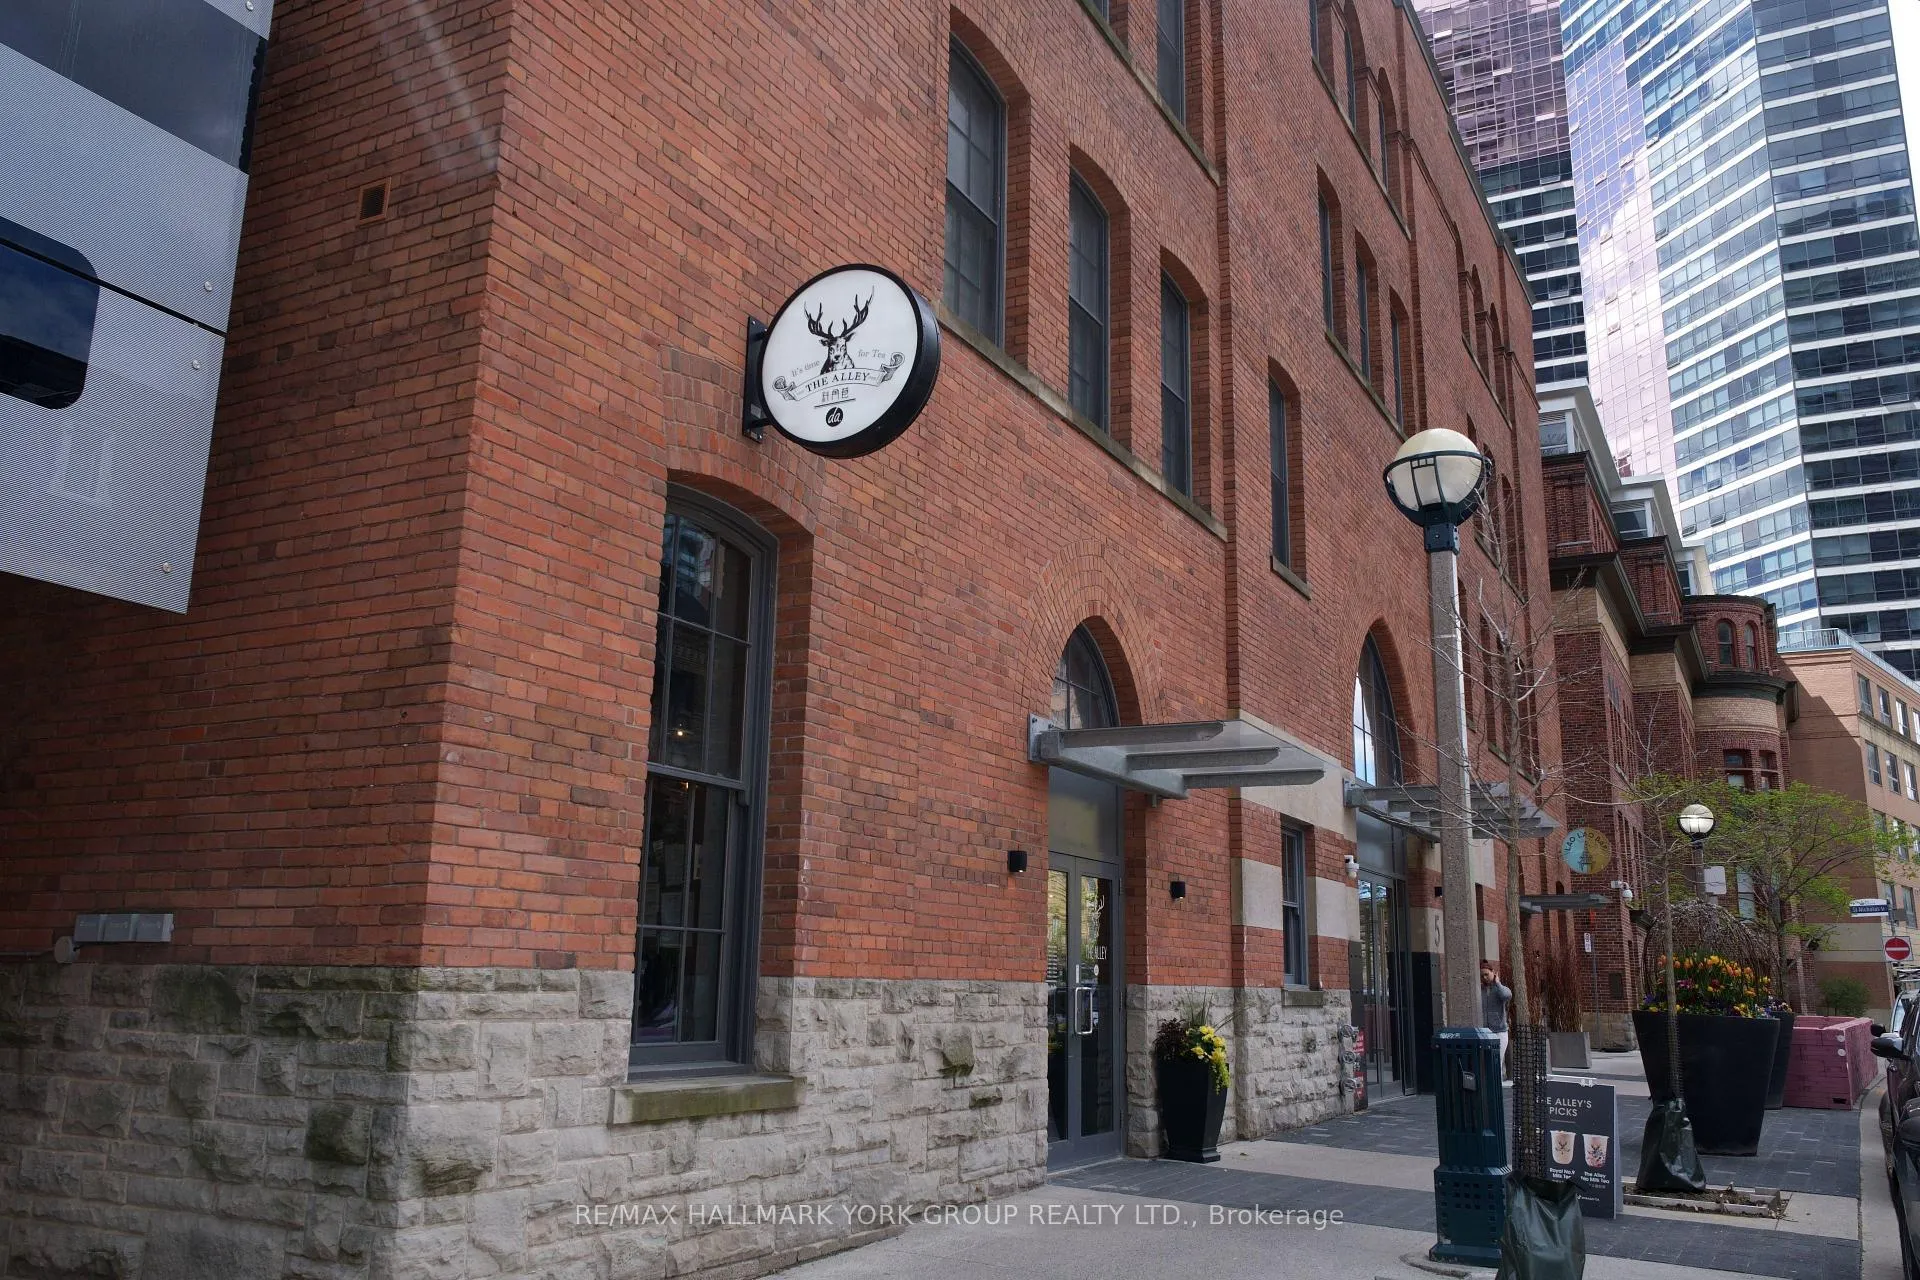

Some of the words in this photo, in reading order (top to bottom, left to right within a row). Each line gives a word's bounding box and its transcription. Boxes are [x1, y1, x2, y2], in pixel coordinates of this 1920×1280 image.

[858, 349, 869, 358] for
[871, 349, 886, 359] Tea
[805, 376, 829, 392] THE
[831, 372, 870, 382] ALLEY
[1564, 836, 1576, 851] LAO
[1555, 1097, 1592, 1108] ALLEY'S
[1549, 1106, 1578, 1117] PICKS
